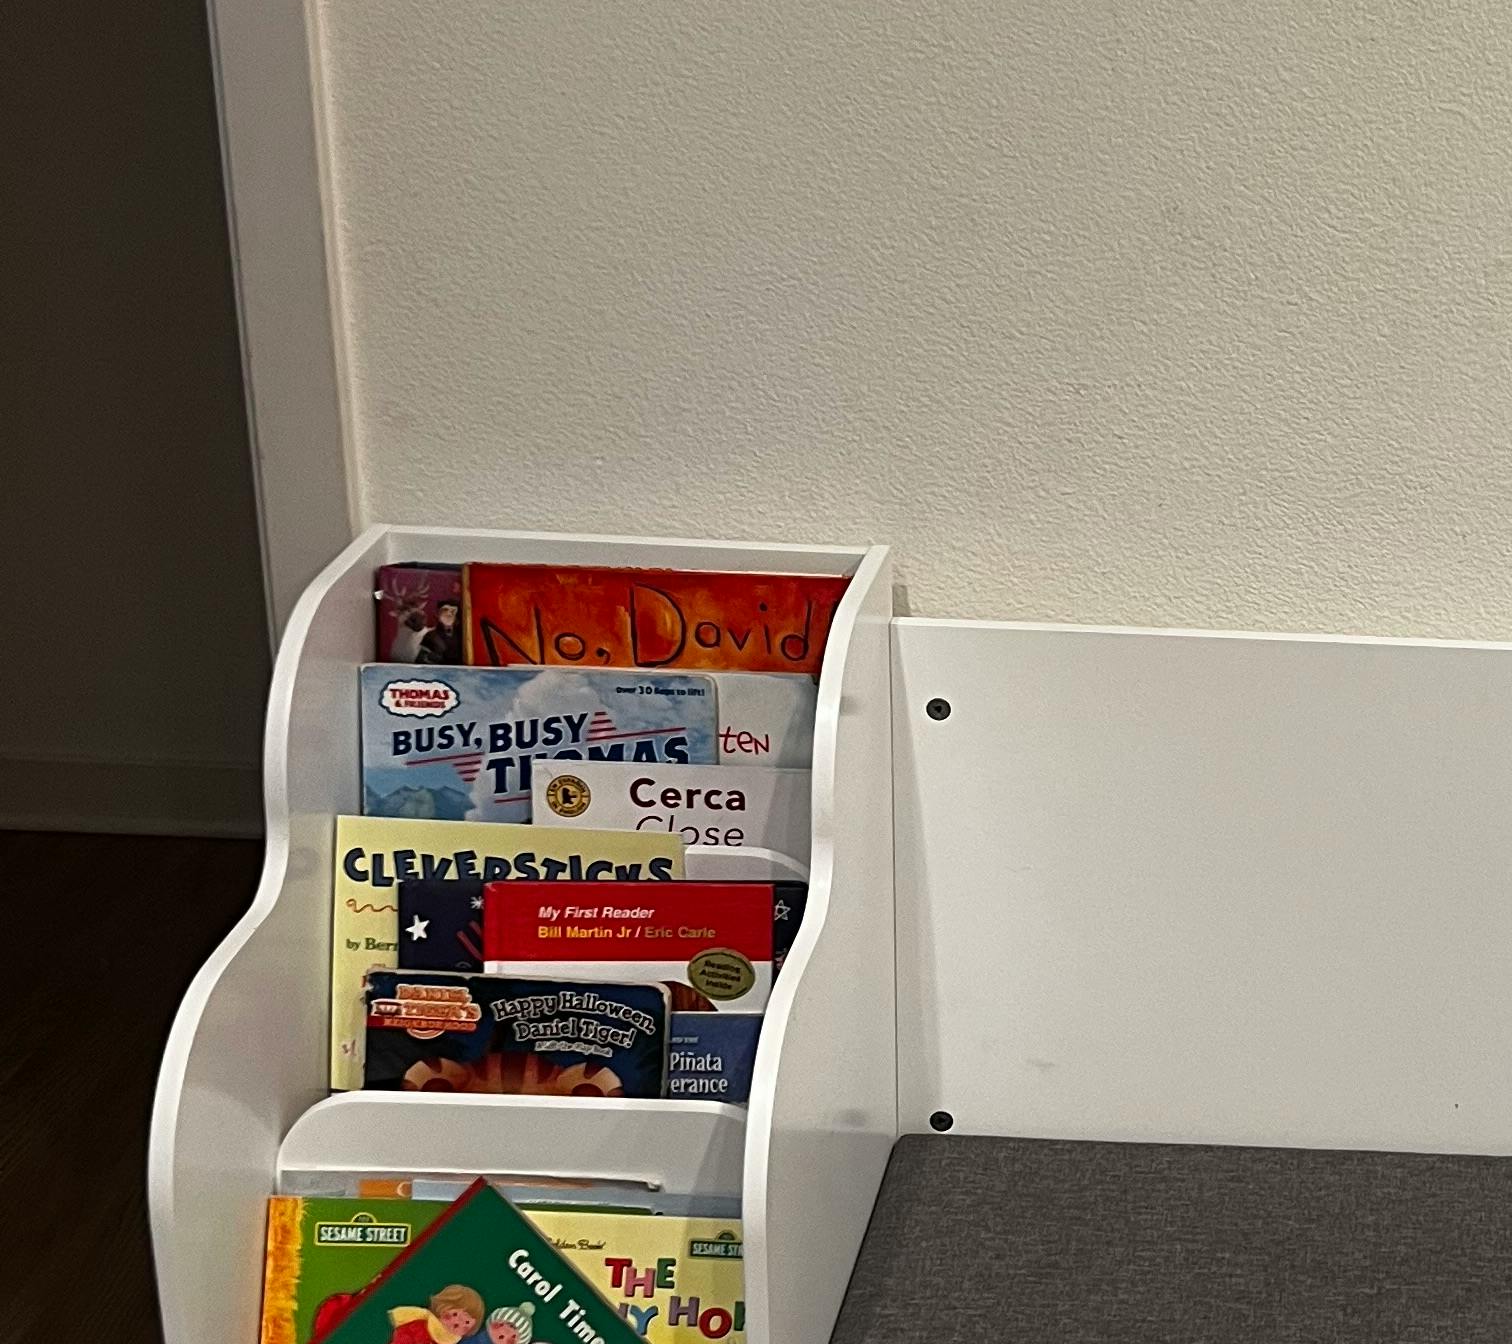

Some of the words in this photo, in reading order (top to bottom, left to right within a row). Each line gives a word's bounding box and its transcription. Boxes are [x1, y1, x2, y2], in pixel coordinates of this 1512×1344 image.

[480, 606, 611, 665] No,
[629, 581, 814, 668] David
[389, 688, 450, 700] THOMAS
[638, 686, 653, 695] 30
[392, 721, 483, 757] BUSY,
[488, 712, 589, 754] BUSY
[486, 736, 690, 795] TMAS
[629, 777, 746, 811] Cerca
[343, 847, 674, 888] CLEVERSTICKS
[538, 906, 561, 921] My
[564, 907, 599, 919] First
[601, 907, 655, 919] Reader
[537, 926, 562, 939] Bill
[566, 926, 613, 939] Martin
[616, 926, 632, 939] Jr
[644, 926, 673, 939] Eric
[677, 926, 717, 939] Carle
[346, 938, 362, 952] by
[491, 999, 557, 1022] Happy
[512, 1017, 578, 1041] Daniel
[579, 1018, 637, 1048] Tiger!
[670, 1051, 723, 1072] Piñata
[669, 1078, 728, 1093] erance
[320, 1226, 363, 1242] SESAME
[366, 1227, 406, 1242] STREET
[692, 1243, 726, 1255] SESAME
[508, 1248, 563, 1304] Carol
[604, 1257, 677, 1298] THE
